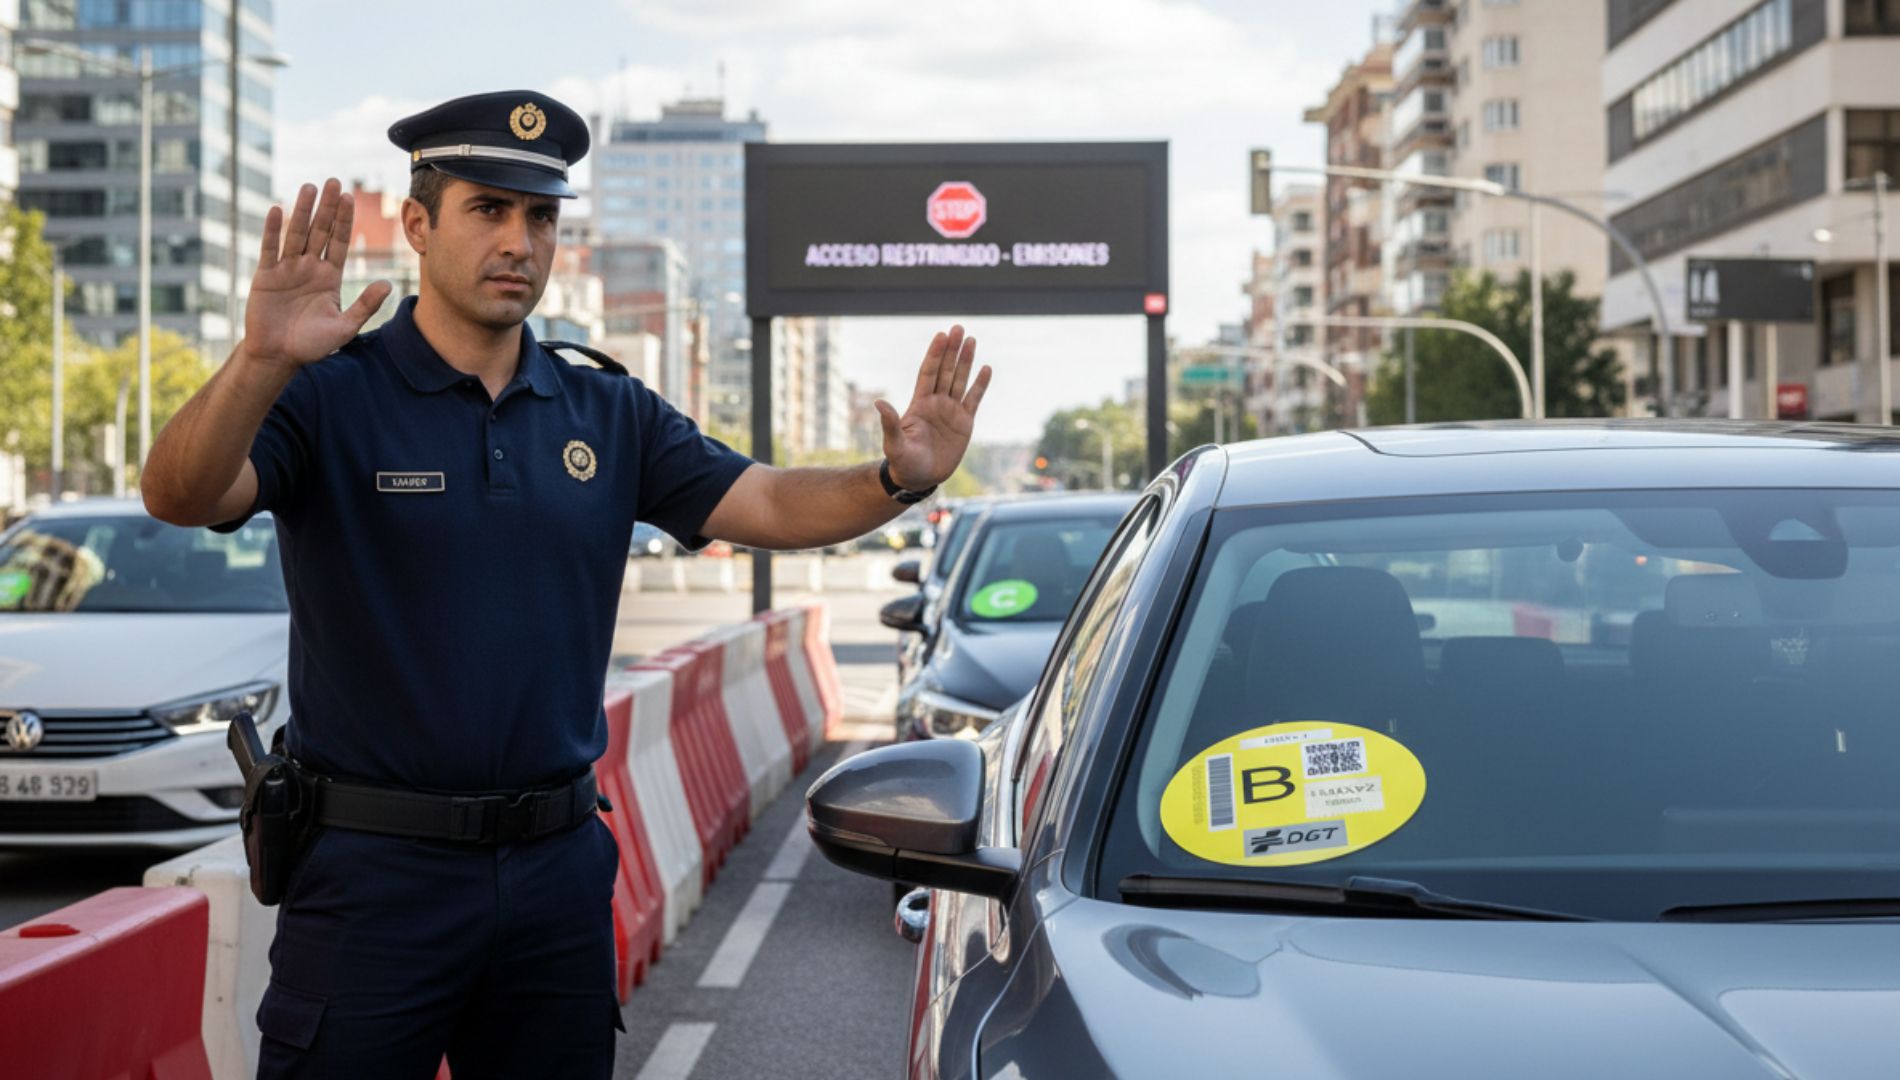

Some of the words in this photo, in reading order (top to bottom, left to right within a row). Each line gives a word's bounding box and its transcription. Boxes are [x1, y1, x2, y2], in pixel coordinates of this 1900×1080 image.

[934, 200, 979, 220] STOP
[805, 243, 880, 267] ACCESO
[990, 588, 1018, 609] C
[1242, 766, 1295, 804] B
[1287, 827, 1339, 845] DGT
